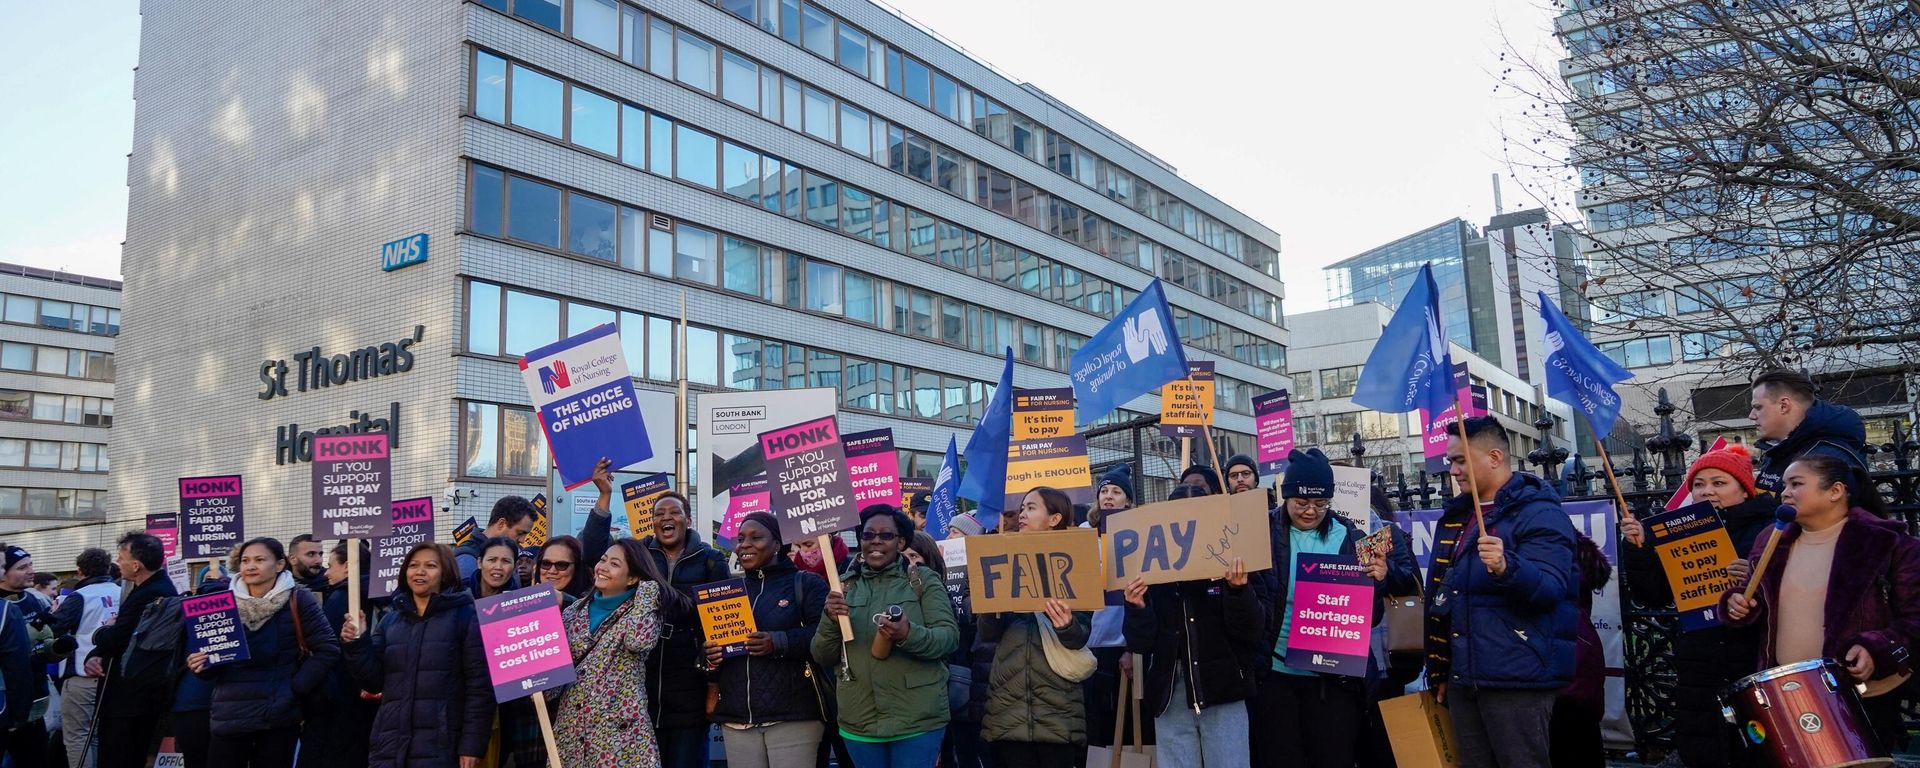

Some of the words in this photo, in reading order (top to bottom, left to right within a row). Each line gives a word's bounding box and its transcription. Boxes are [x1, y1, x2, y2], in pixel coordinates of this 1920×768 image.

[383, 236, 421, 268] NHS
[570, 362, 591, 377] Royal
[591, 353, 617, 367] College
[258, 359, 289, 400] St
[573, 376, 581, 385] of
[583, 367, 611, 382] Nursing
[552, 401, 579, 418] THE
[581, 385, 624, 406] VOICE
[552, 419, 570, 432] OF
[574, 397, 633, 426] NURSING
[1024, 416, 1039, 424] It's
[1186, 411, 1208, 420] fairy
[715, 423, 746, 431] LONDON
[1029, 426, 1039, 434] to
[1041, 426, 1059, 435] pay
[767, 424, 832, 454] HONK
[862, 435, 889, 444] STAFFING
[1429, 432, 1448, 444] cost
[320, 440, 383, 456] HONK
[1038, 447, 1070, 455] NURSING
[785, 458, 796, 469] IF
[796, 450, 824, 464] YOU
[332, 462, 343, 473] IF
[345, 461, 371, 472] YOU
[778, 459, 836, 483] SUPPORT
[851, 462, 878, 475] Staff
[322, 472, 381, 485] SUPPORT
[1007, 471, 1031, 481] ough
[1034, 470, 1042, 478] is
[1045, 467, 1086, 477] ENOUGH
[185, 481, 236, 495] HONK
[781, 480, 812, 495] FAIR
[813, 471, 838, 487] PAY
[852, 475, 893, 488] ortages
[1347, 481, 1366, 490] College
[324, 485, 353, 496] FAIR
[356, 483, 381, 494] PAY
[799, 488, 827, 503] FOR
[856, 493, 866, 501] st
[867, 488, 893, 499] lives
[1338, 488, 1358, 497] Nursing
[195, 499, 204, 507] IF
[339, 496, 365, 507] FOR
[633, 501, 646, 509] It's
[742, 499, 759, 508] Staff
[940, 487, 954, 510] Royal
[188, 505, 236, 516] SUPPORT
[322, 506, 382, 519] NURSING
[392, 504, 426, 519] ONK
[786, 495, 845, 519] NURSING
[189, 516, 213, 525] FAIR
[215, 515, 235, 523] PAY
[935, 502, 949, 534] Nursing
[1665, 518, 1682, 528] FAIR
[1682, 514, 1696, 523] PAY
[1669, 525, 1685, 534] FOR
[1684, 515, 1716, 530] NURSING
[202, 524, 224, 532] FOR
[397, 524, 418, 535] YOU
[189, 532, 237, 542] NURSING
[379, 534, 426, 547] SUPPORT
[379, 547, 404, 557] FAIR
[1113, 520, 1198, 579] PAY
[1202, 522, 1240, 567] for
[1670, 546, 1689, 559] It's
[1690, 539, 1718, 553] time
[1681, 561, 1694, 570] to
[1696, 554, 1718, 569] pay
[947, 571, 964, 580] time
[979, 552, 1078, 600] FAIR
[1319, 569, 1340, 577] SAVES
[1683, 567, 1729, 585] nursing
[720, 587, 743, 596] NURSING
[947, 583, 961, 592] pay
[1680, 585, 1707, 601] staff
[1709, 579, 1740, 594] fairly
[187, 596, 231, 613] HONK
[500, 598, 518, 608] SAFE
[519, 590, 551, 603] STAFFING
[1317, 594, 1350, 607] Staff
[721, 602, 742, 611] time
[208, 612, 226, 620] YOU
[724, 611, 740, 620] pay
[1299, 608, 1365, 625] shortages
[194, 618, 234, 632] SUPPORT
[507, 620, 540, 638] Staff
[713, 619, 745, 631] nursing
[1594, 619, 1611, 630] afe.
[196, 629, 217, 639] FAIR
[218, 625, 235, 634] PAY
[710, 631, 729, 641] staff
[731, 627, 753, 637] fairly
[1300, 624, 1327, 637] cost
[1329, 625, 1361, 640] lives
[208, 635, 227, 644] FOR
[493, 631, 560, 656] shortages
[200, 640, 240, 653] NURSING
[499, 653, 528, 669] cost
[529, 645, 560, 661] lives
